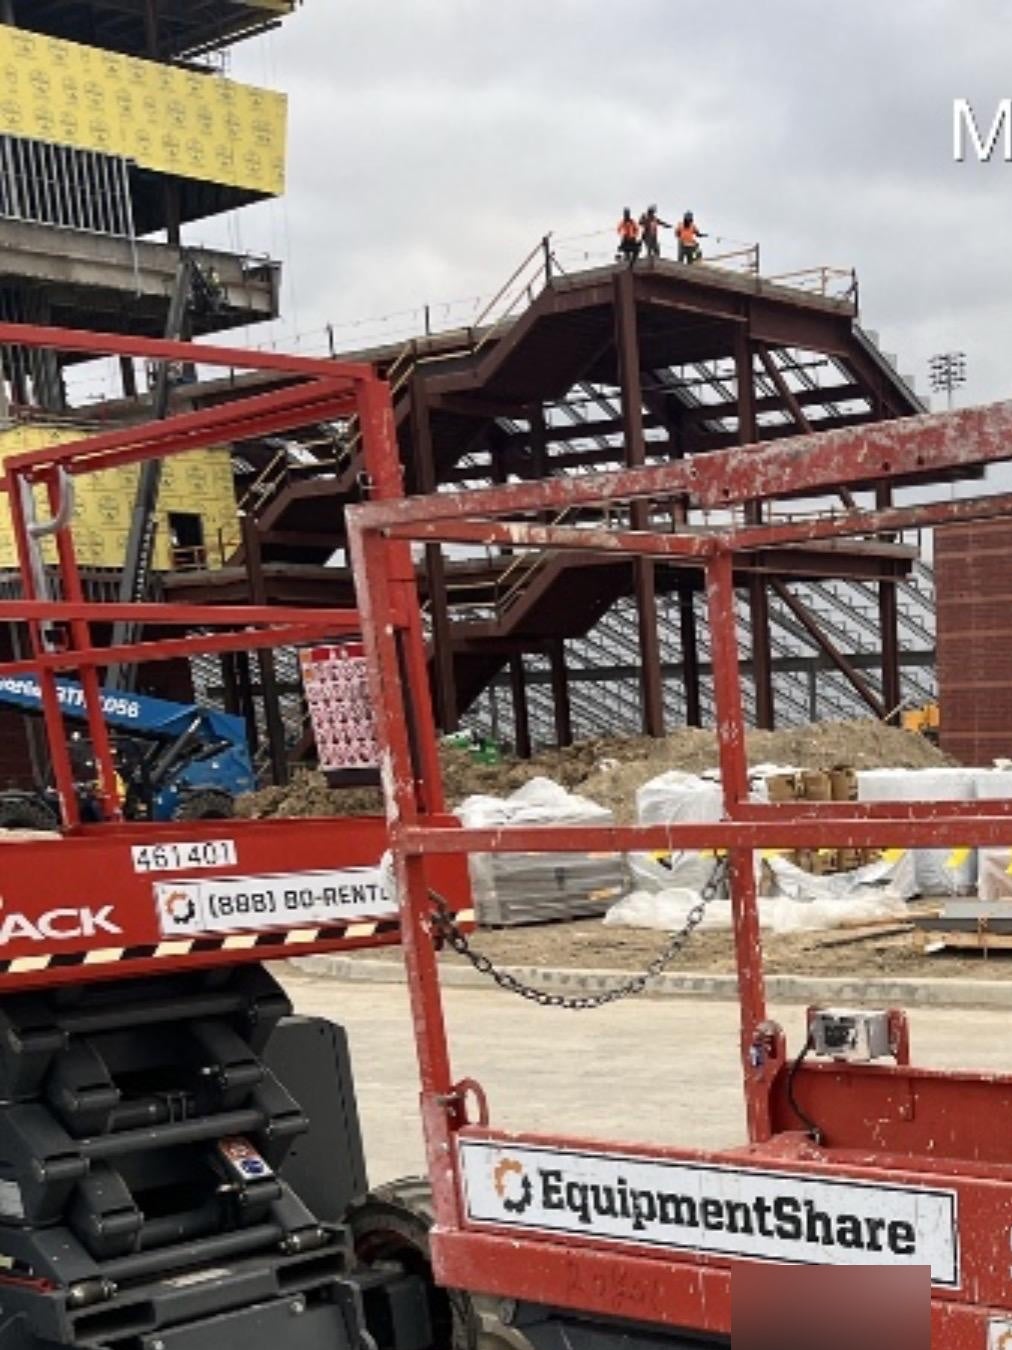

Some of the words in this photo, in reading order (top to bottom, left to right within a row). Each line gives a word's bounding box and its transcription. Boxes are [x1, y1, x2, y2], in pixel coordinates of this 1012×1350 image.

[135, 842, 233, 871] 461401
[208, 889, 276, 920] (888)
[537, 1168, 916, 1256] EquipmentShare
